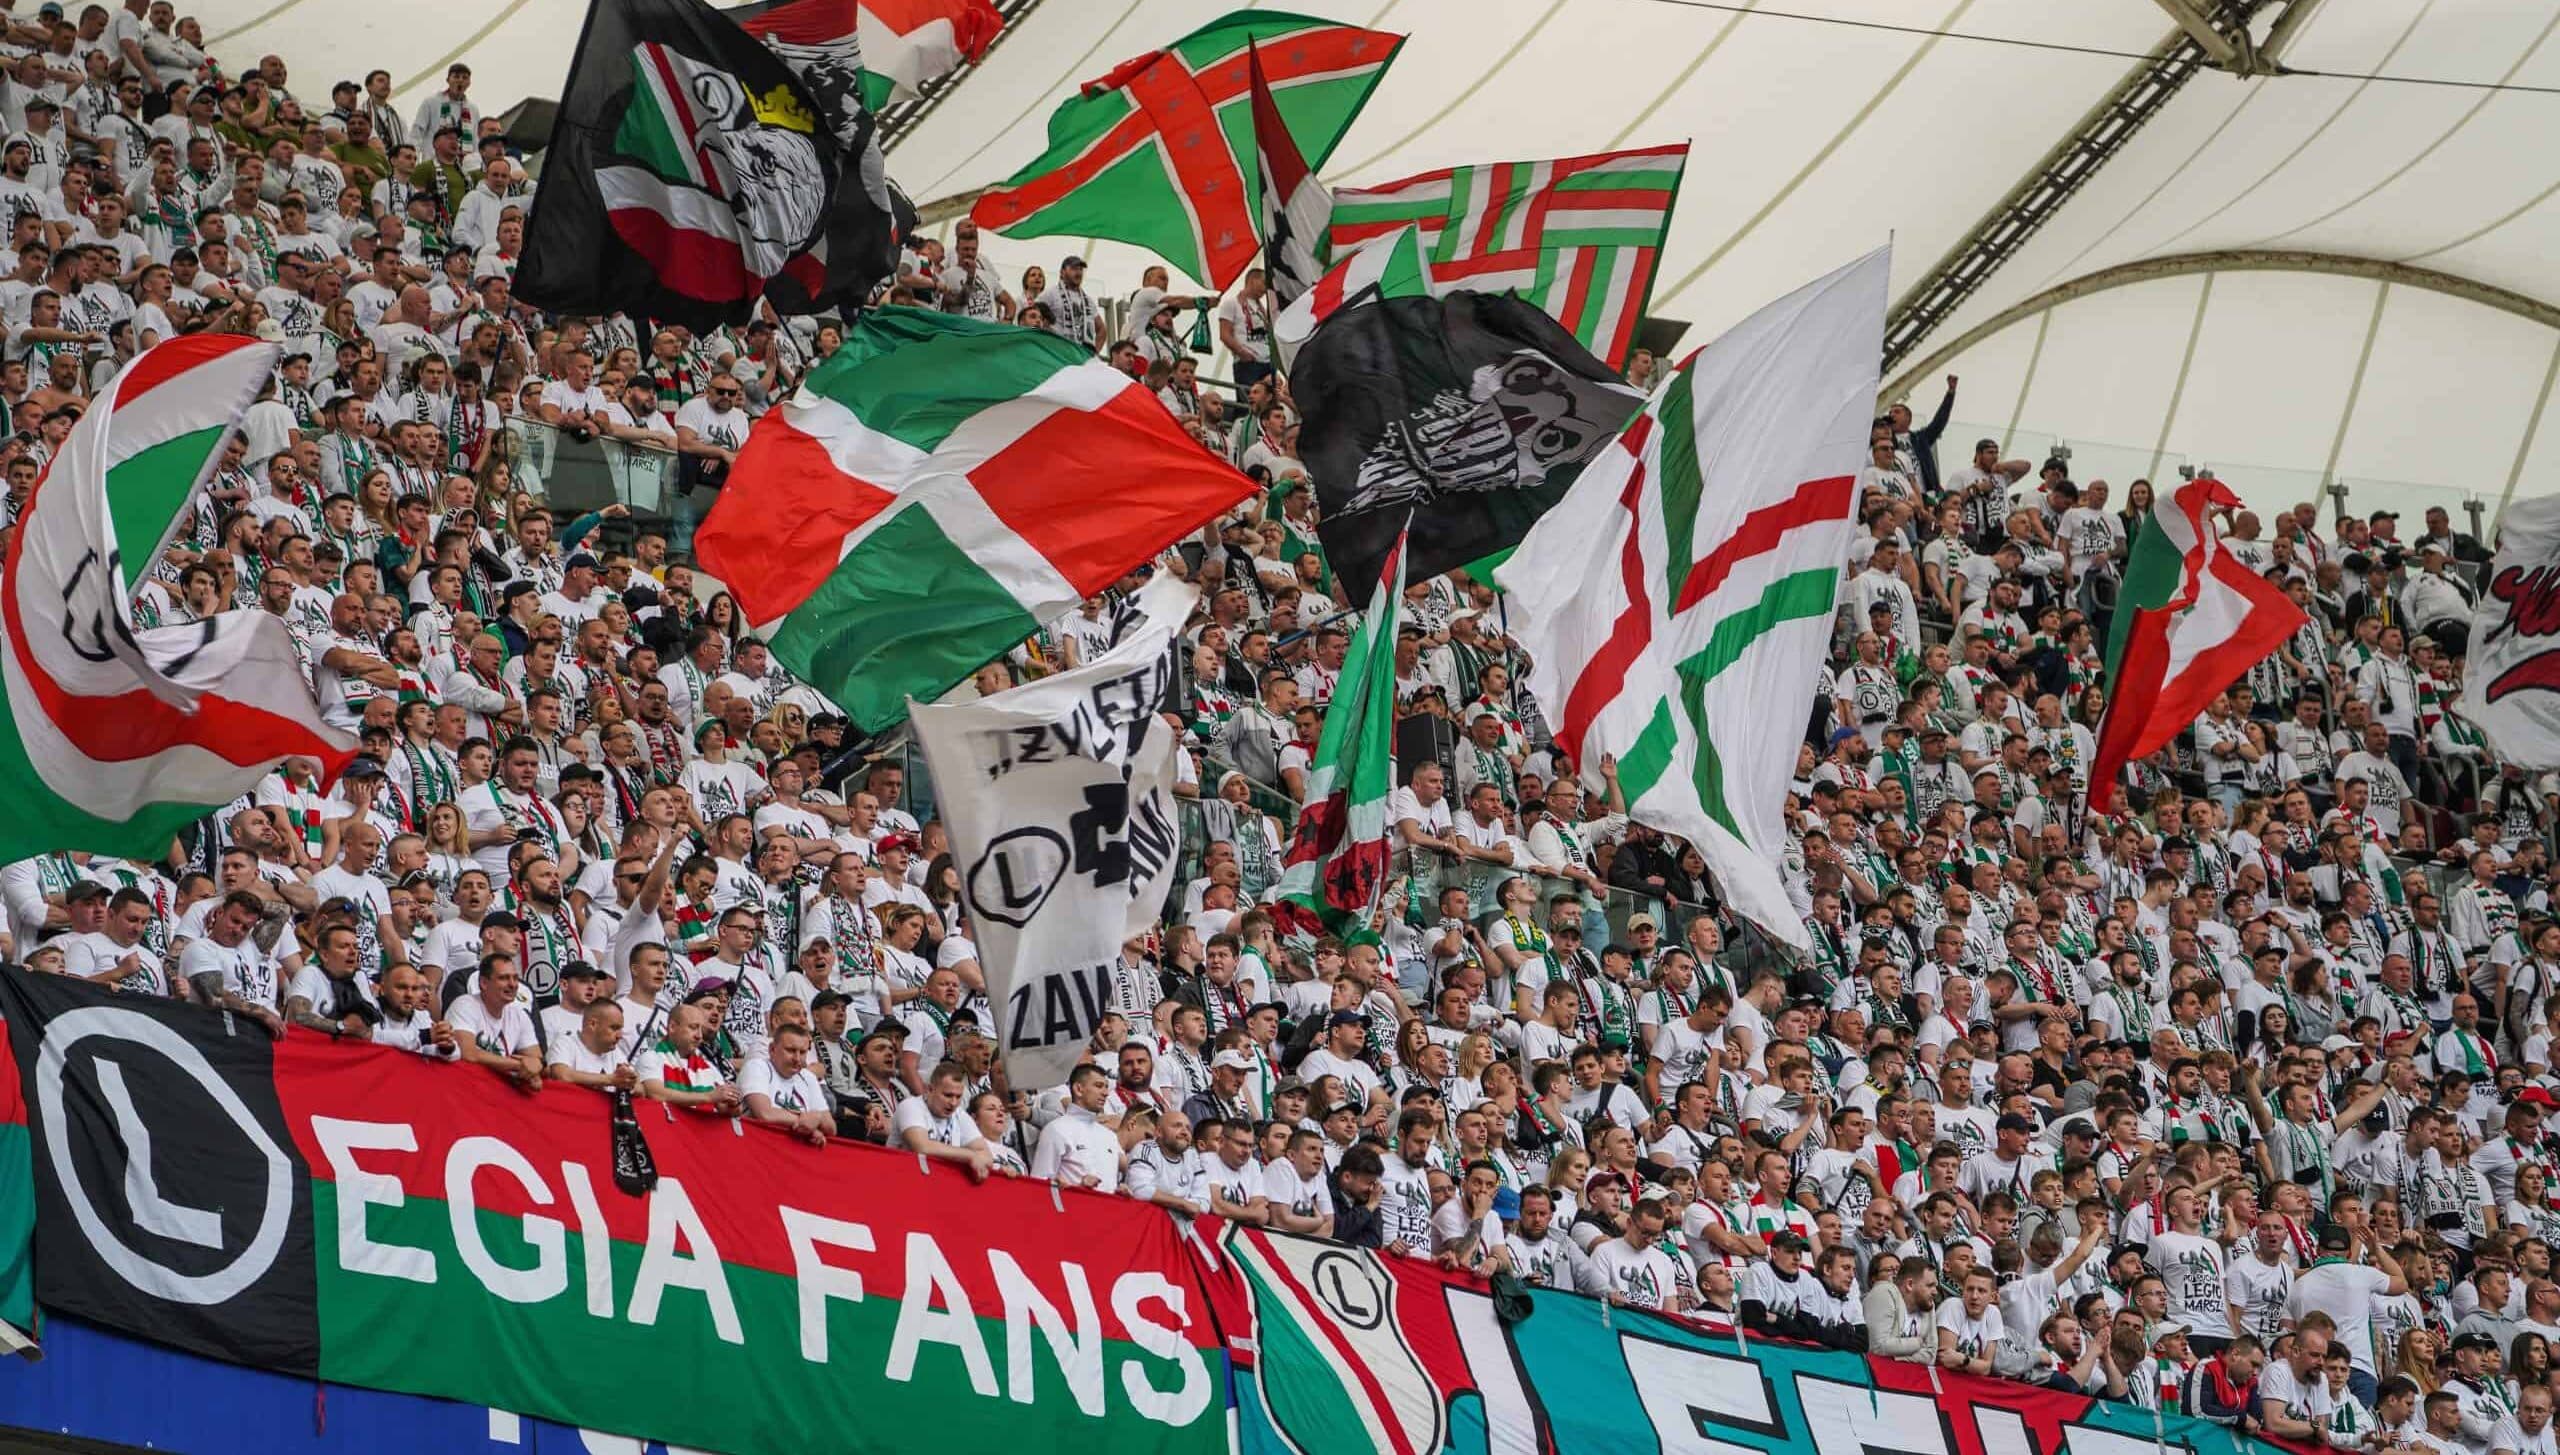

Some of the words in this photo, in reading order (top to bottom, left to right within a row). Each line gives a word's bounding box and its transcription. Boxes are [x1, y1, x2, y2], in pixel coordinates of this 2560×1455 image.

[995, 851, 1042, 908] L
[536, 967, 549, 988] L
[779, 1205, 1213, 1427] FANS
[1329, 1265, 1369, 1317] L
